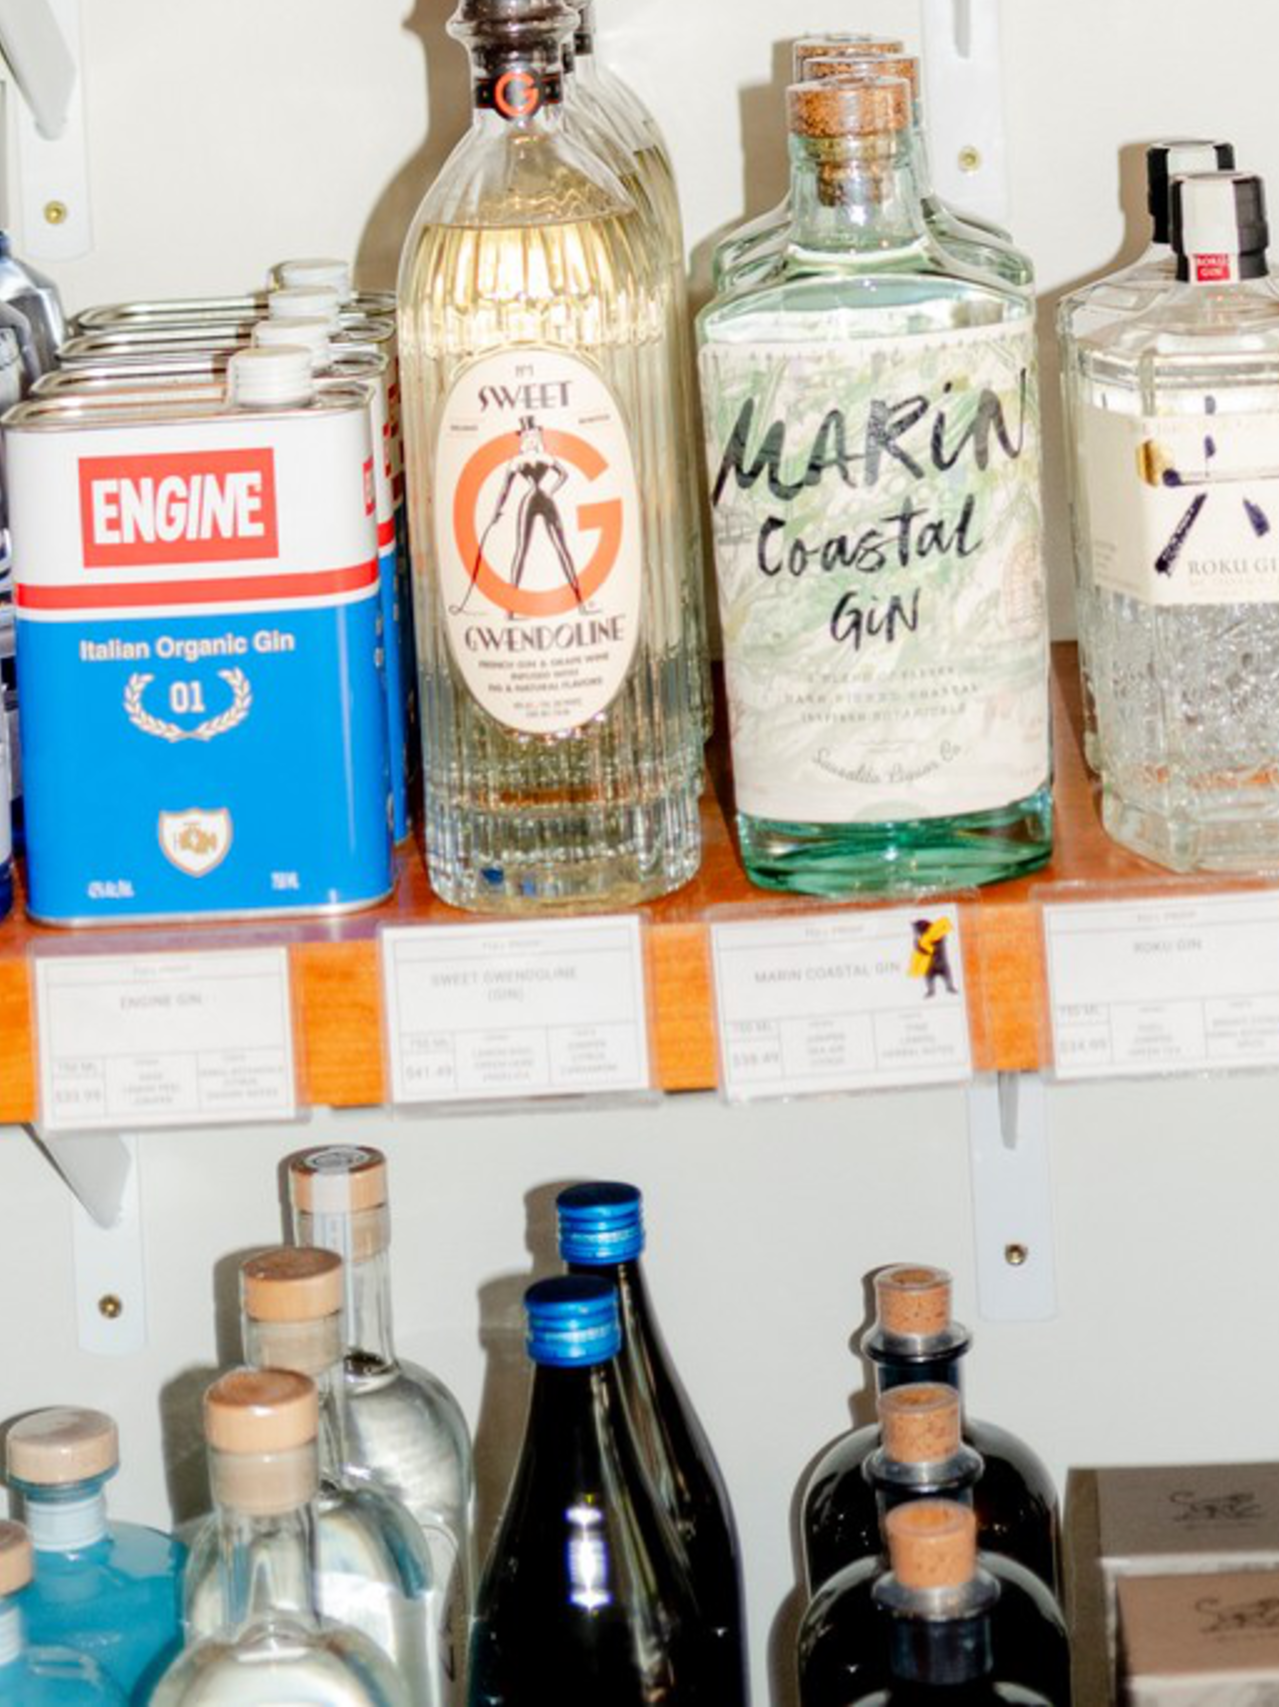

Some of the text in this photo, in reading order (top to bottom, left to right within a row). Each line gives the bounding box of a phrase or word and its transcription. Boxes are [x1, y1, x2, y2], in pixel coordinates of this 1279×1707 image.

[477, 380, 573, 412] SWEET
[91, 471, 265, 545] ENGINE
[757, 493, 984, 577] Coastal
[1187, 558, 1249, 576] ROKU
[80, 629, 295, 663] Italian Organic Gin
[464, 614, 627, 652] GWENDOLINE
[169, 680, 206, 715] 01
